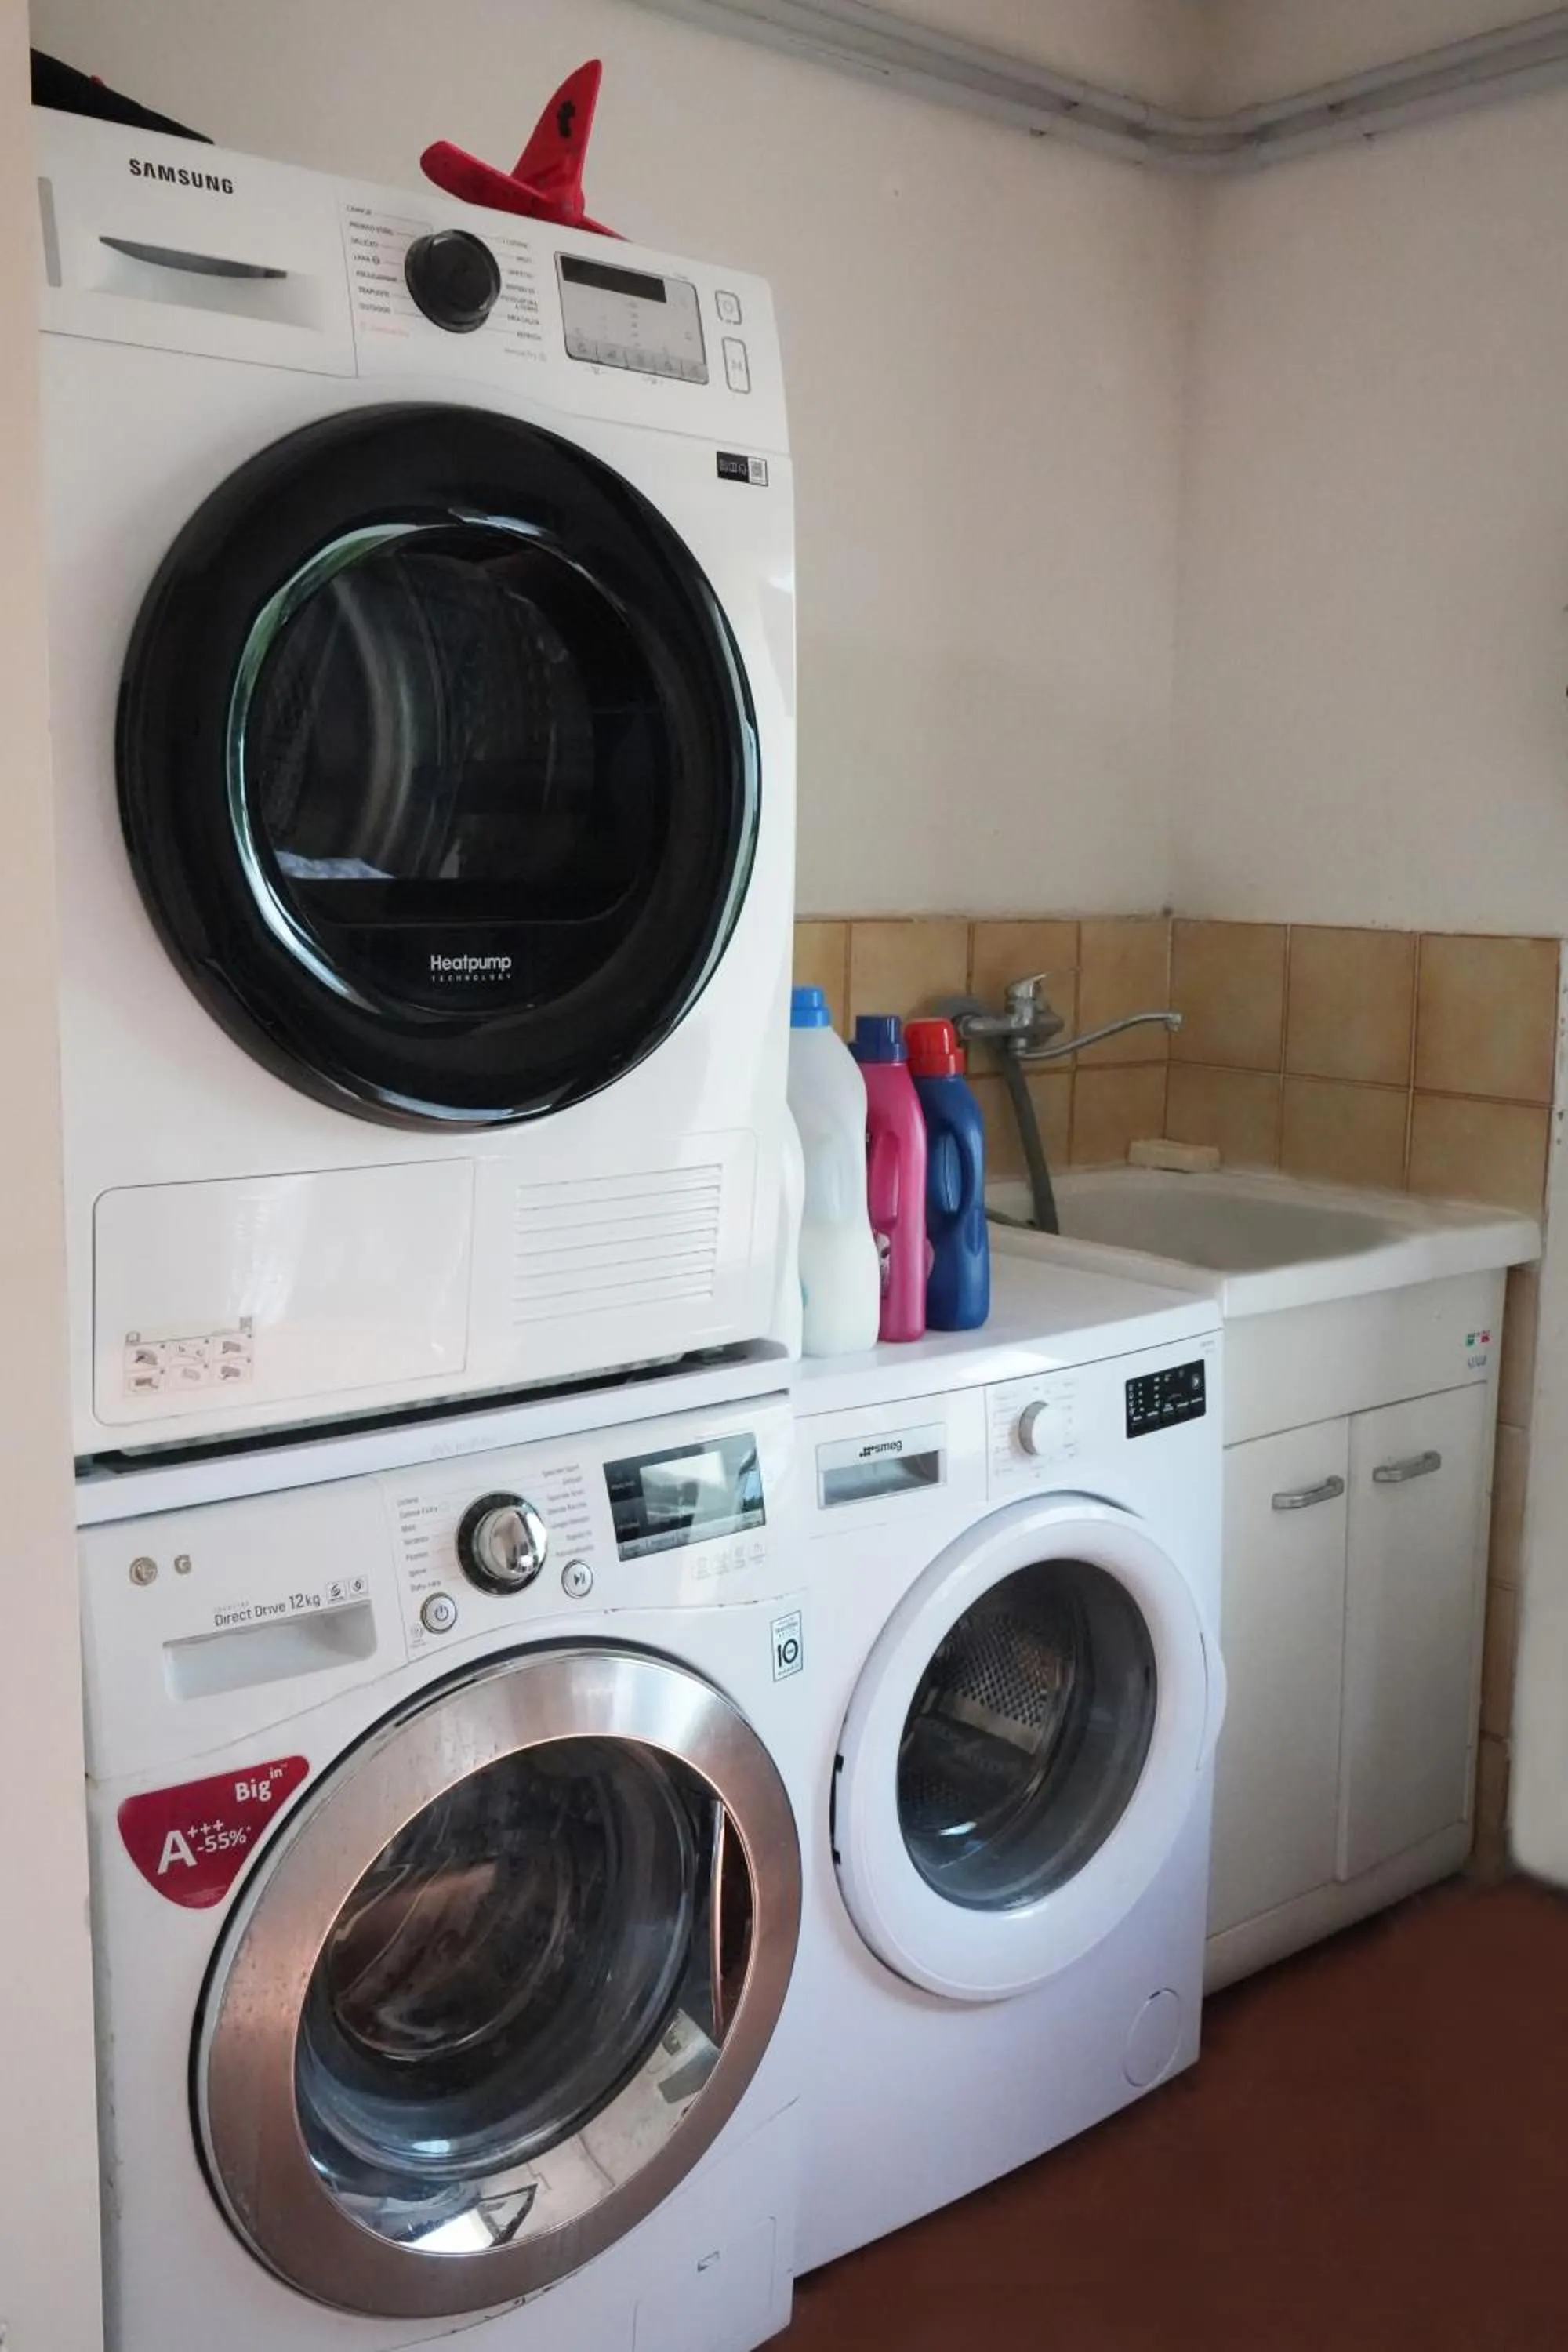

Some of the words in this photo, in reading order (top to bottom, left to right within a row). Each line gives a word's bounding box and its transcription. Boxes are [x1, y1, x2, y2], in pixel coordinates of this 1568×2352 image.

[129, 158, 234, 195] SAMSUNG
[430, 954, 512, 973] Heatpump
[214, 1609, 252, 1627] Direct
[255, 1602, 286, 1618] Drive
[234, 1777, 272, 1802] Big
